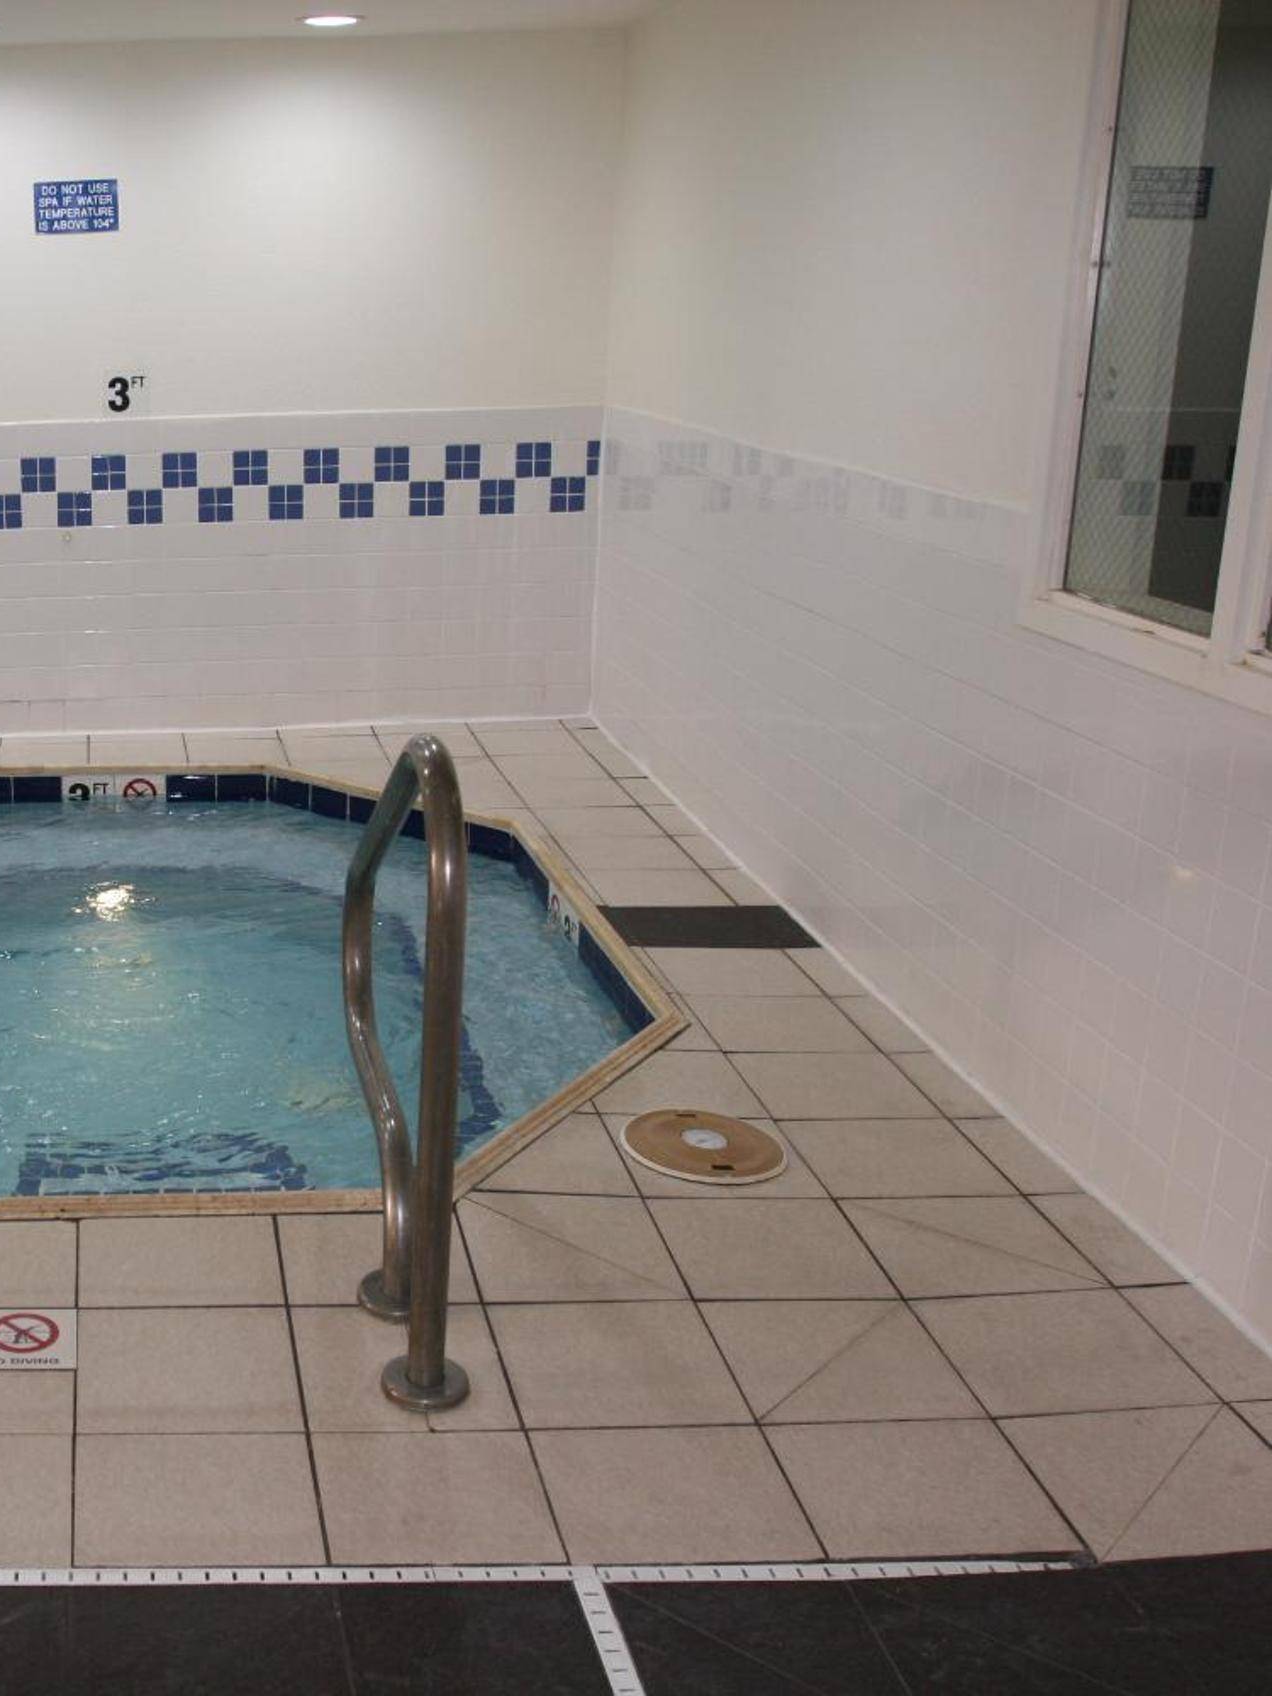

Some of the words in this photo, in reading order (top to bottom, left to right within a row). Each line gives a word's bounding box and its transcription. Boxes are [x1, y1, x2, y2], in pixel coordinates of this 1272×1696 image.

[41, 185, 57, 196] DO
[61, 184, 84, 195] NOT
[88, 182, 109, 194] USE
[38, 197, 58, 208] SPA
[62, 196, 73, 206] IF
[76, 194, 113, 206] WATER
[38, 206, 115, 219] TEMPERATURE
[38, 221, 48, 232] IS
[52, 219, 89, 231] ABOVE
[108, 376, 130, 412] 3
[130, 376, 147, 389] FT
[93, 783, 109, 795] FT
[10, 1357, 60, 1365] DIVING
